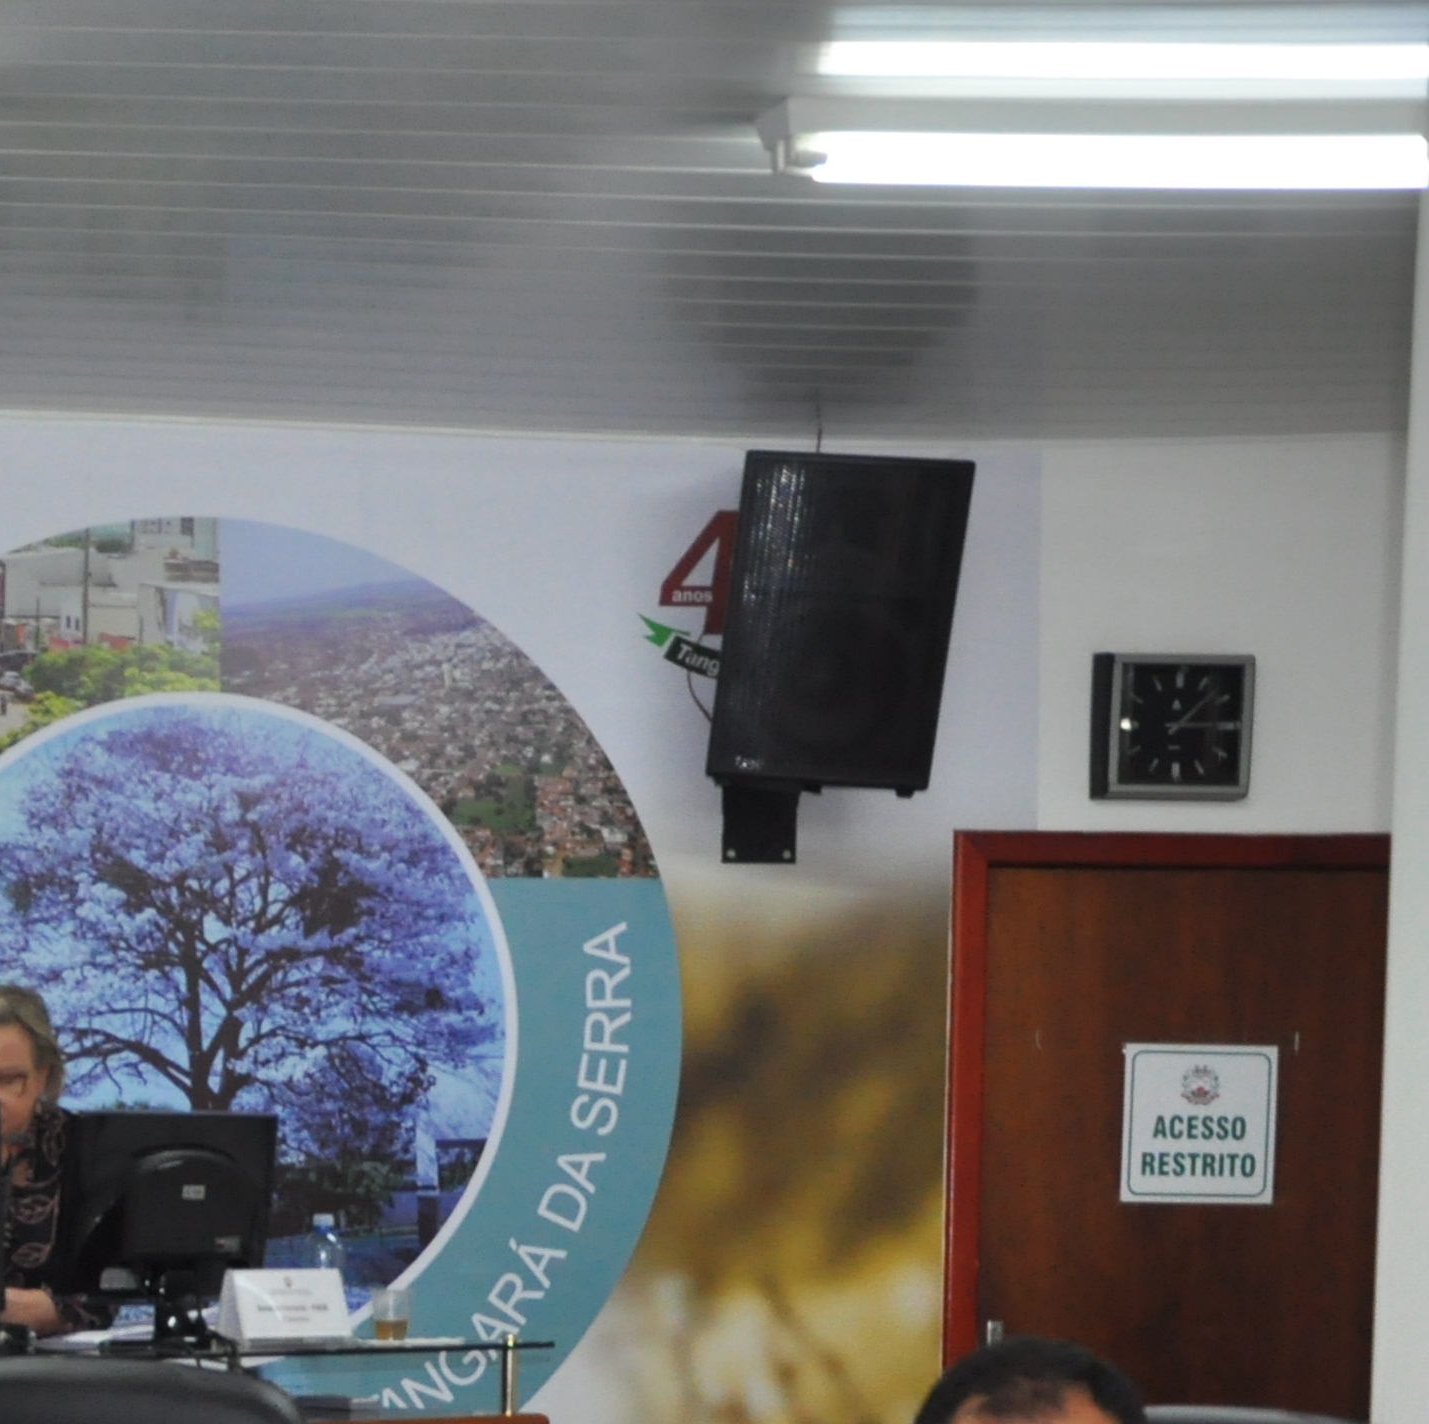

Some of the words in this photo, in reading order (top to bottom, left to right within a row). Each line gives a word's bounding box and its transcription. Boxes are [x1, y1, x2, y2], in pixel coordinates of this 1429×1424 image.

[672, 589, 713, 603] anos
[570, 921, 632, 1136] SERRA
[1152, 1114, 1247, 1141] ACESSO
[1141, 1152, 1256, 1178] RESTRITO
[537, 1152, 607, 1232] DA
